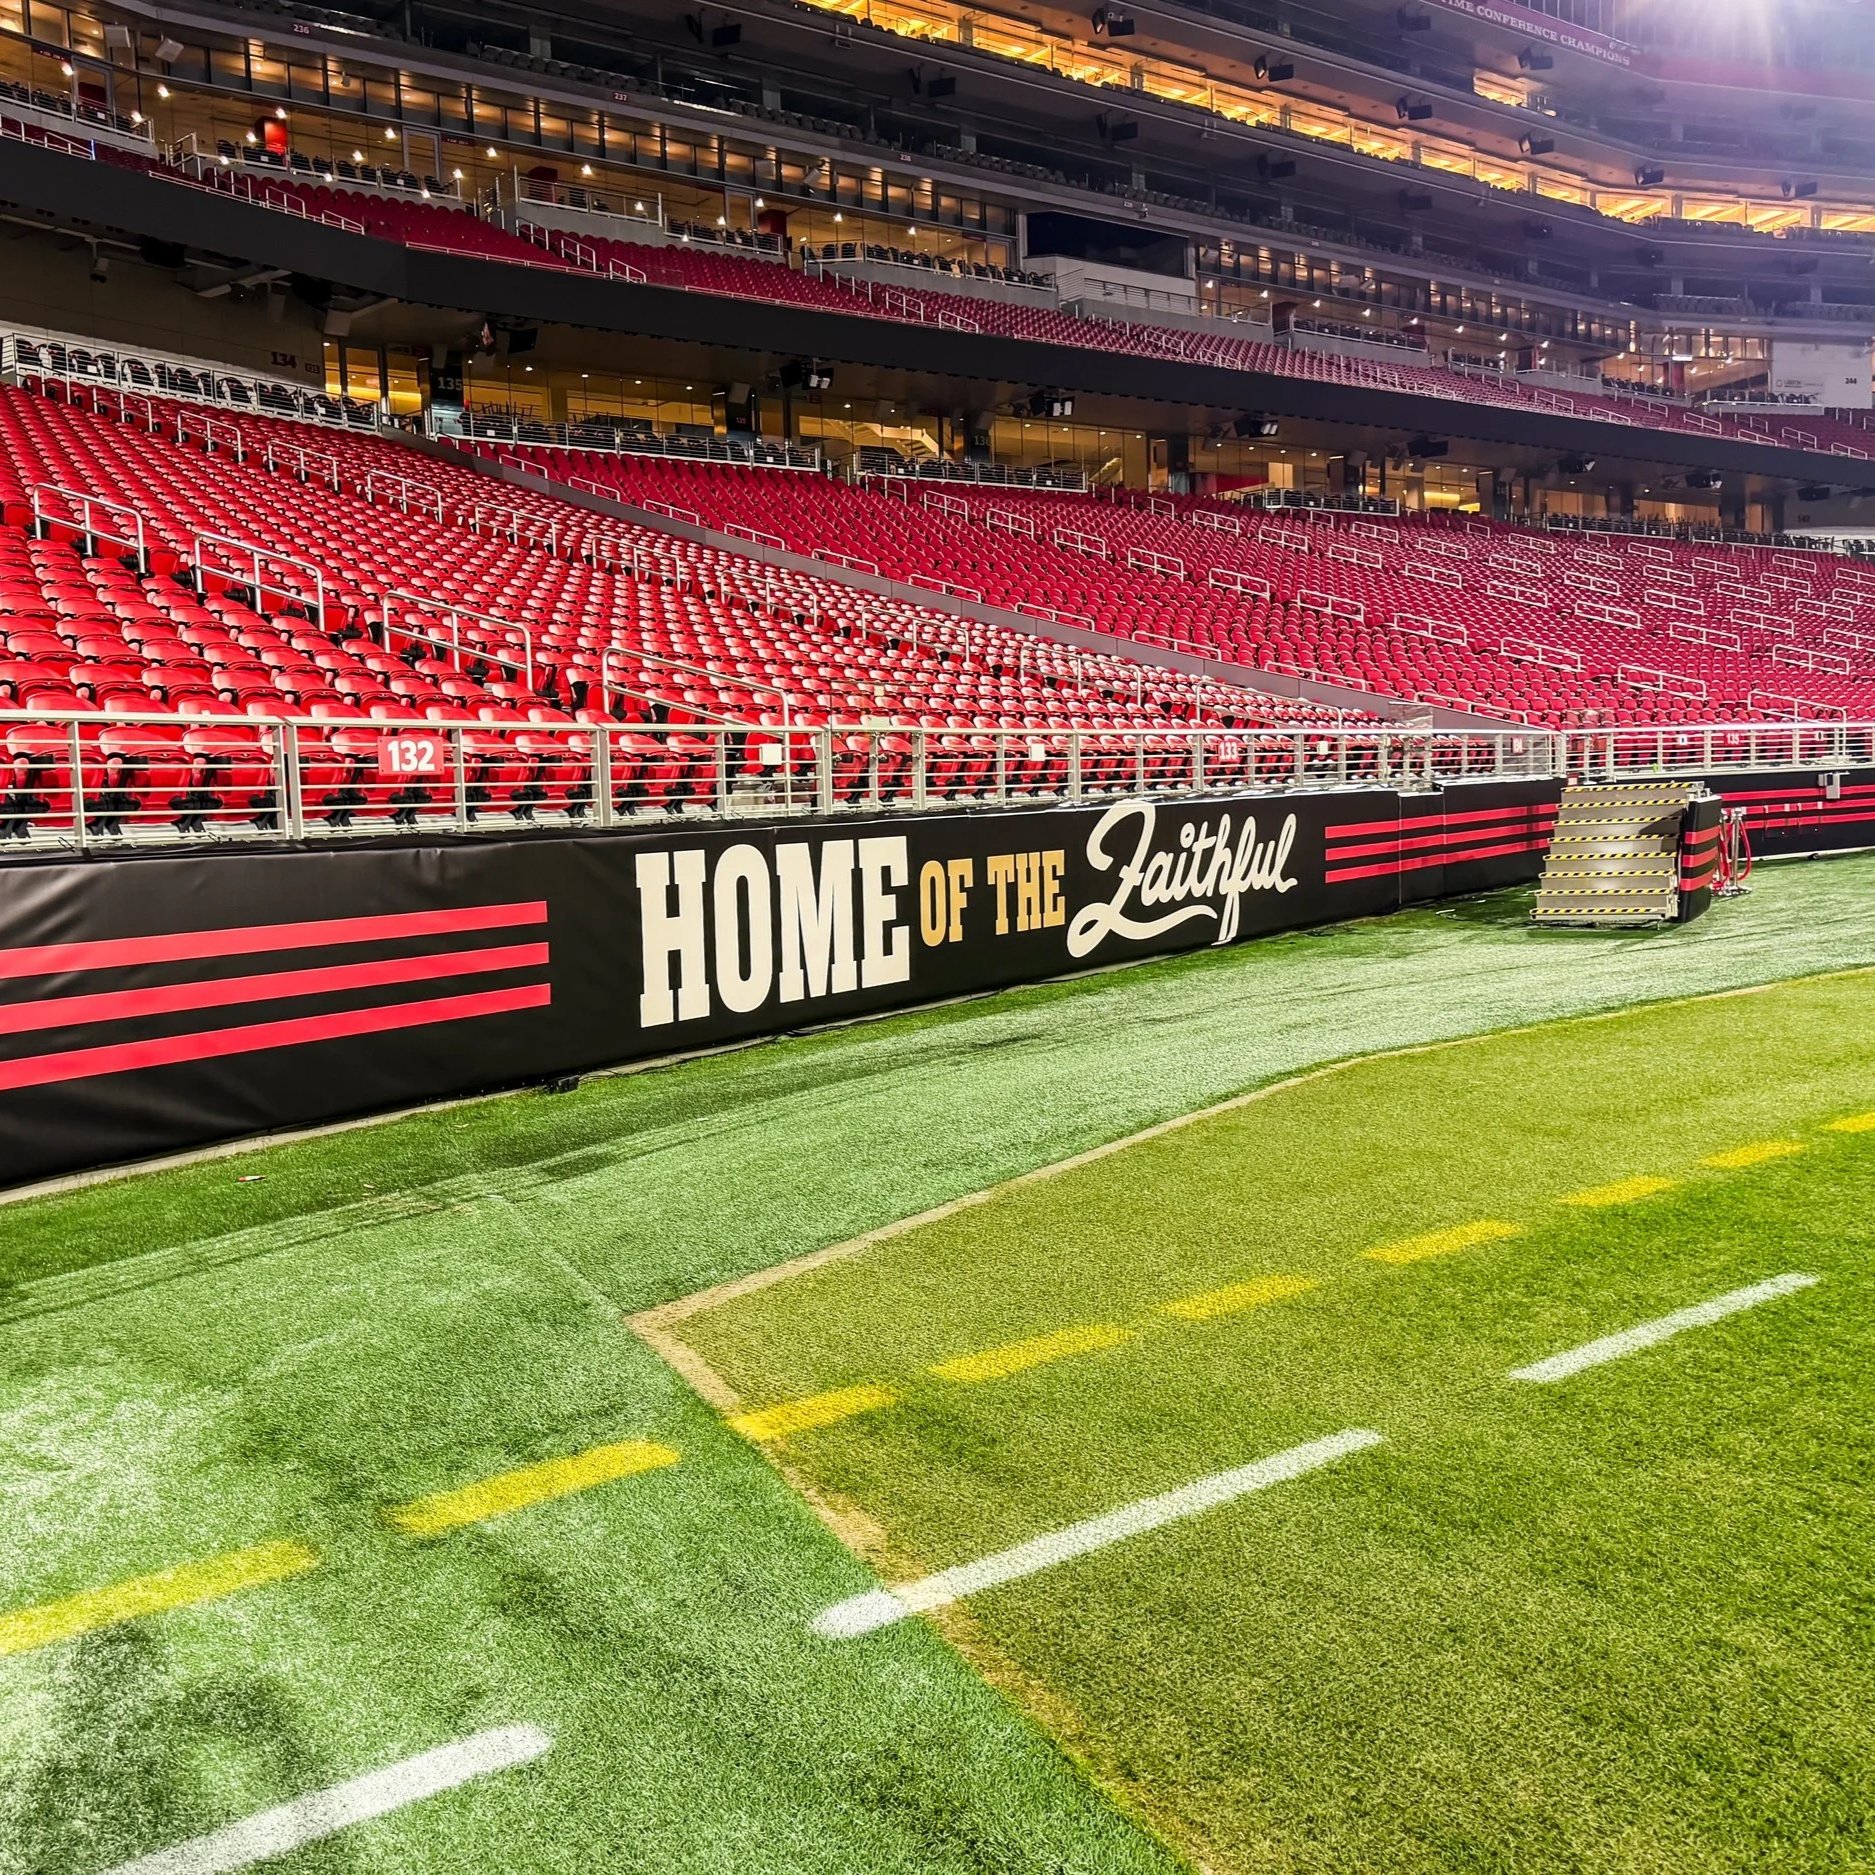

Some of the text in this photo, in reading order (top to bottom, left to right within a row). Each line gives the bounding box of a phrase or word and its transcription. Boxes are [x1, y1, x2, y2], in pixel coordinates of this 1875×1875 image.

[293, 24, 310, 34] 236
[1477, 6, 1558, 41] CONFERENCE
[1560, 34, 1631, 66] CHAMPIONS
[614, 92, 628, 101] 237
[271, 351, 296, 369] 134
[437, 376, 463, 391] 135
[1726, 732, 1740, 745] 135
[387, 740, 436, 772] 132
[1219, 741, 1238, 761] 133
[635, 799, 1298, 1028] HOME OF THE Faithful
